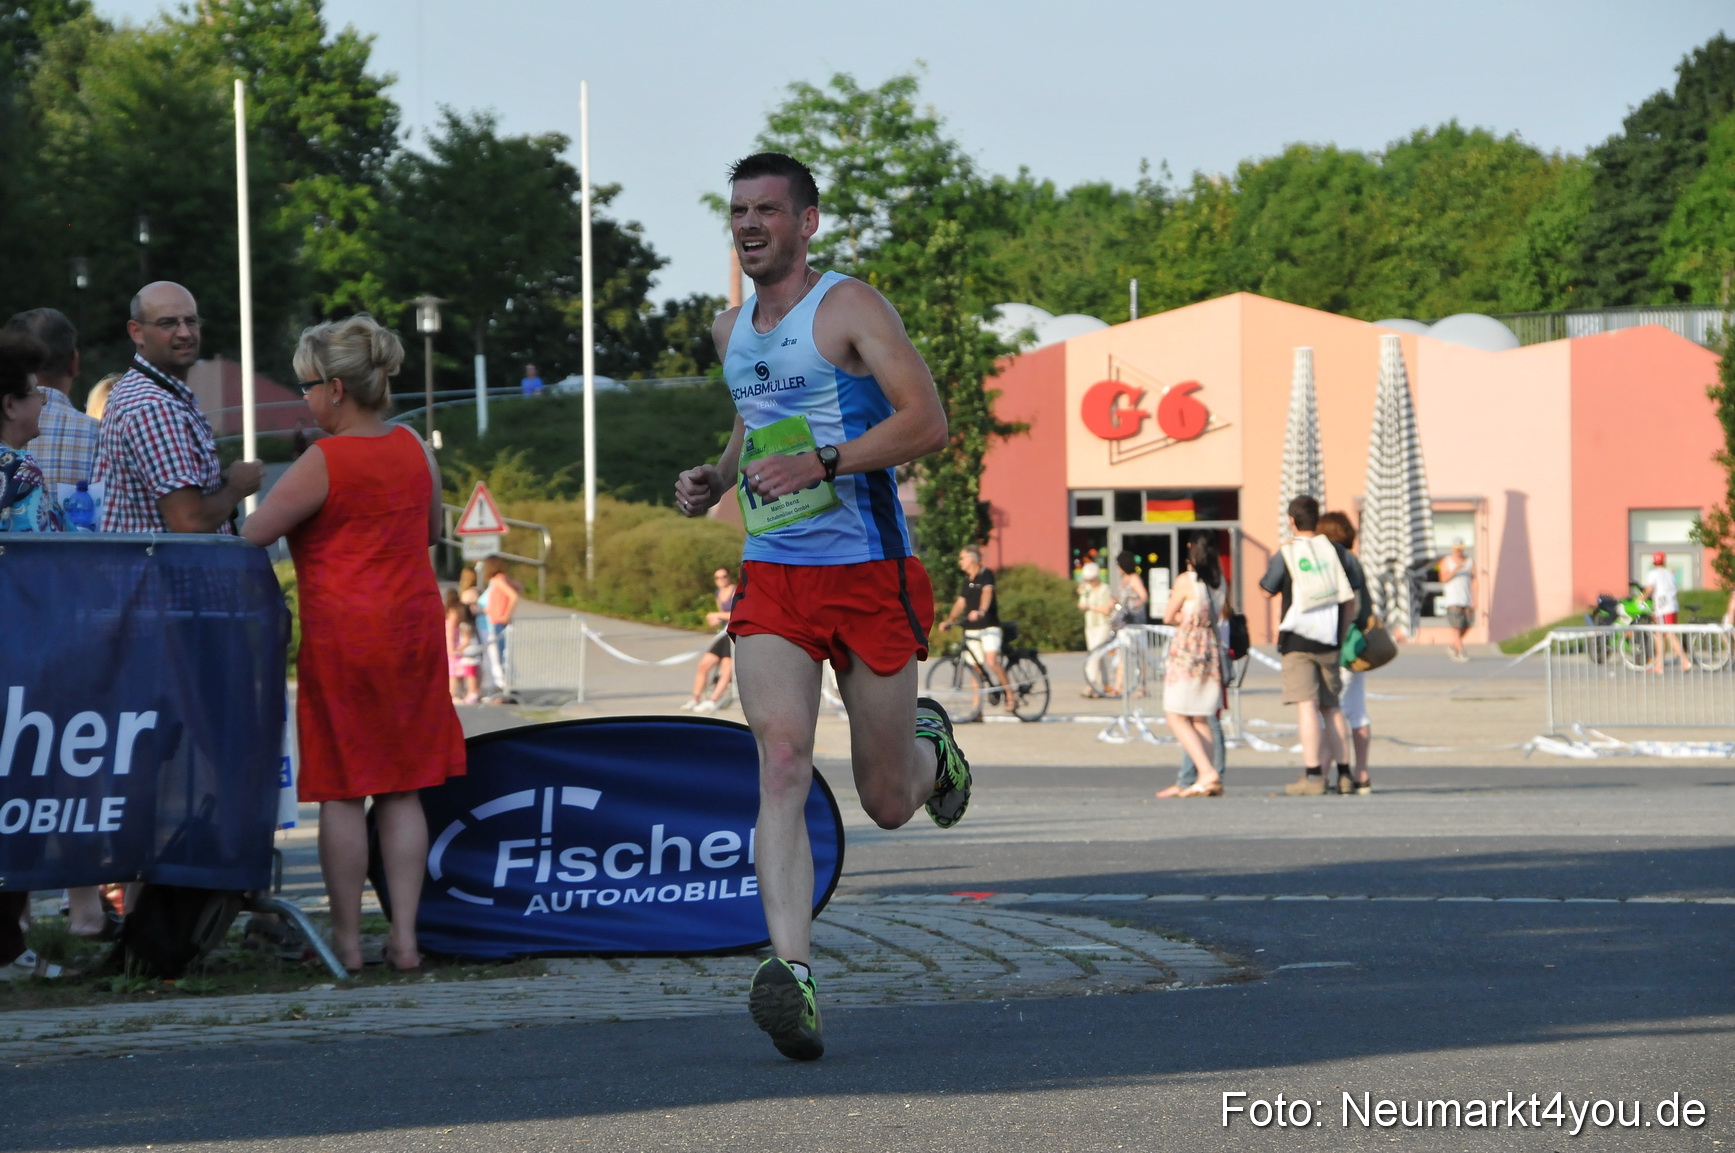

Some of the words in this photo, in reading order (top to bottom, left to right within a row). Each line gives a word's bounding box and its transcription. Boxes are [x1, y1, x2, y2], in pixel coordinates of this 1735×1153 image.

[732, 376, 806, 400] SCHABMÜLLER
[755, 400, 778, 410] TEAM
[1081, 380, 1208, 440] G6
[793, 504, 810, 513] GmbH
[0, 797, 126, 834] OBILE
[523, 876, 758, 916] AUTOMOBILE
